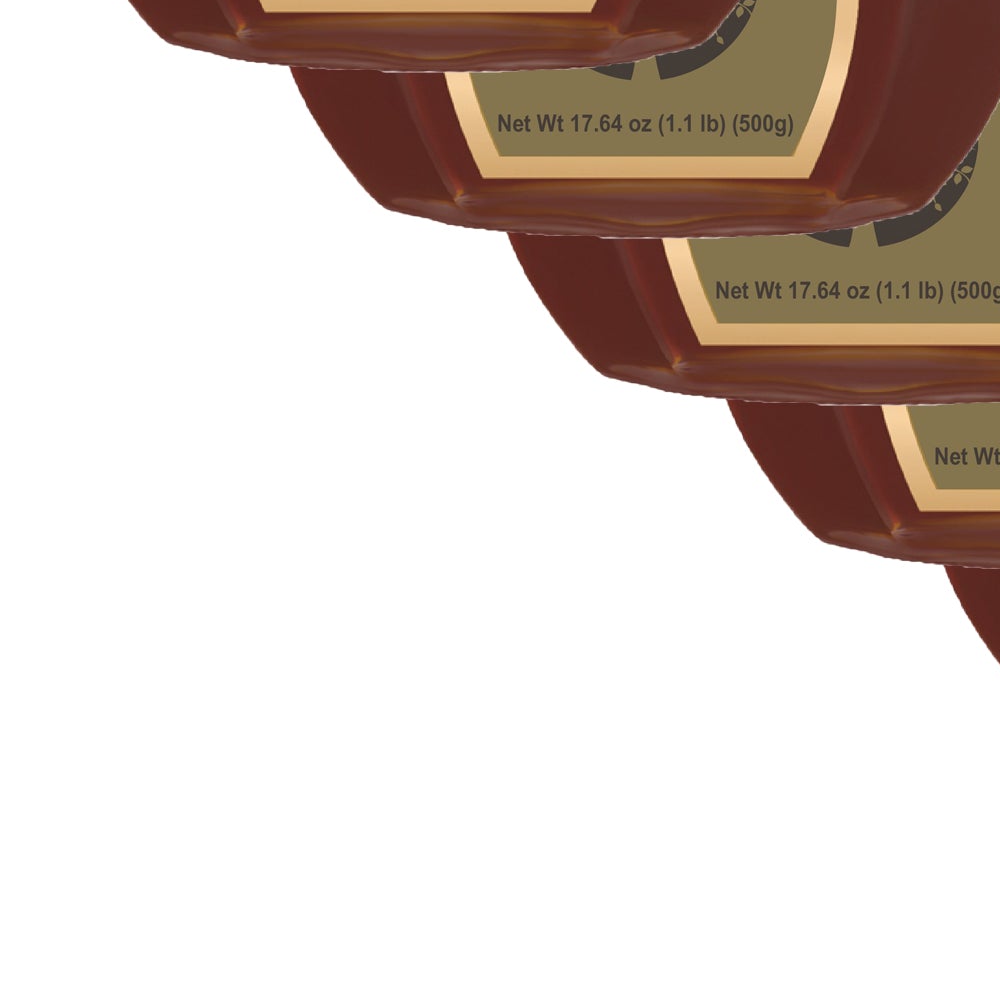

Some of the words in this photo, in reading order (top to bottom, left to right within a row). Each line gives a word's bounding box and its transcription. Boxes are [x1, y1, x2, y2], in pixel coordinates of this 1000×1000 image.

[497, 113, 532, 133] Net
[536, 113, 565, 133] Wt
[570, 113, 623, 133] 17.64
[628, 118, 653, 133] oz
[658, 113, 692, 138] (1.1
[700, 113, 726, 138] lb)
[732, 113, 794, 138] (500g)
[715, 280, 750, 300] Net
[754, 280, 783, 300] Wt
[788, 280, 841, 300] 17.64
[846, 285, 871, 300] oz
[876, 280, 910, 305] (1.1
[918, 280, 944, 305] lb)
[934, 446, 969, 466] Net
[973, 446, 1000, 466] Wt
